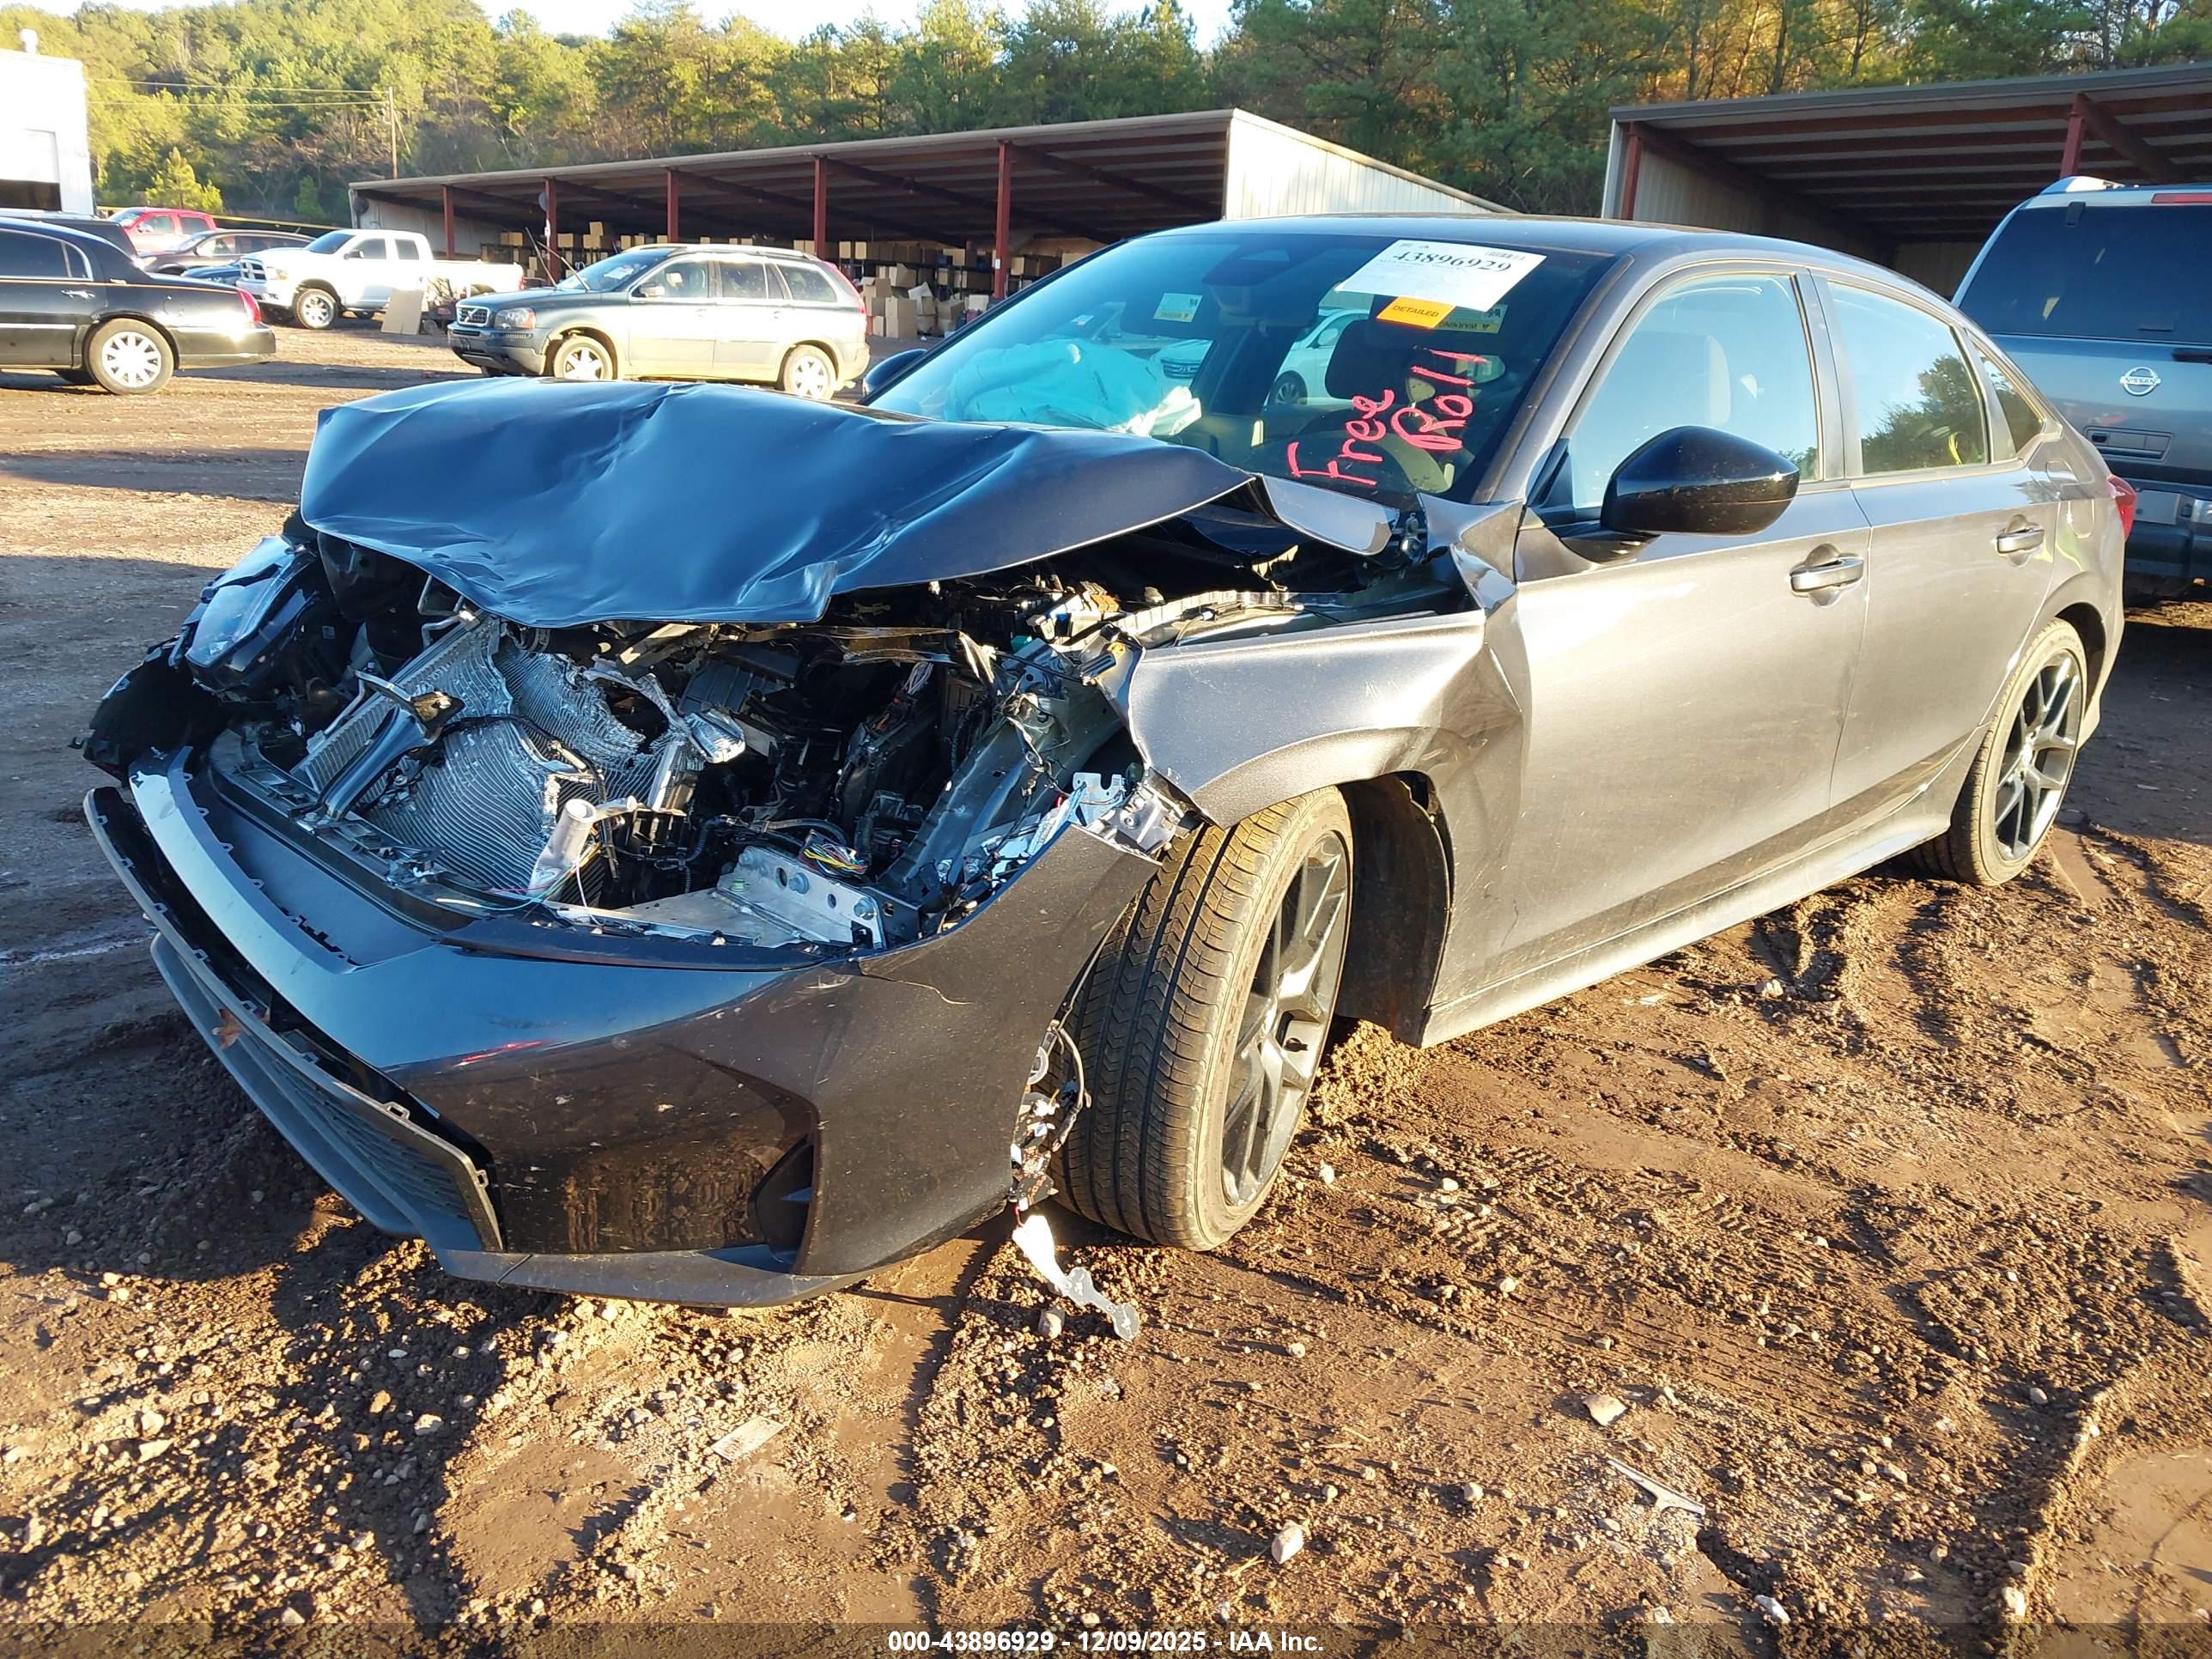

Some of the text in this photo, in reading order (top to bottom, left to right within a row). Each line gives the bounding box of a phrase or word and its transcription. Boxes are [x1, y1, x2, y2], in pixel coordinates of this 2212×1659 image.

[1393, 251, 1512, 272] 43896929
[1393, 304, 1440, 318] DETAILED
[1287, 389, 1395, 486] Free
